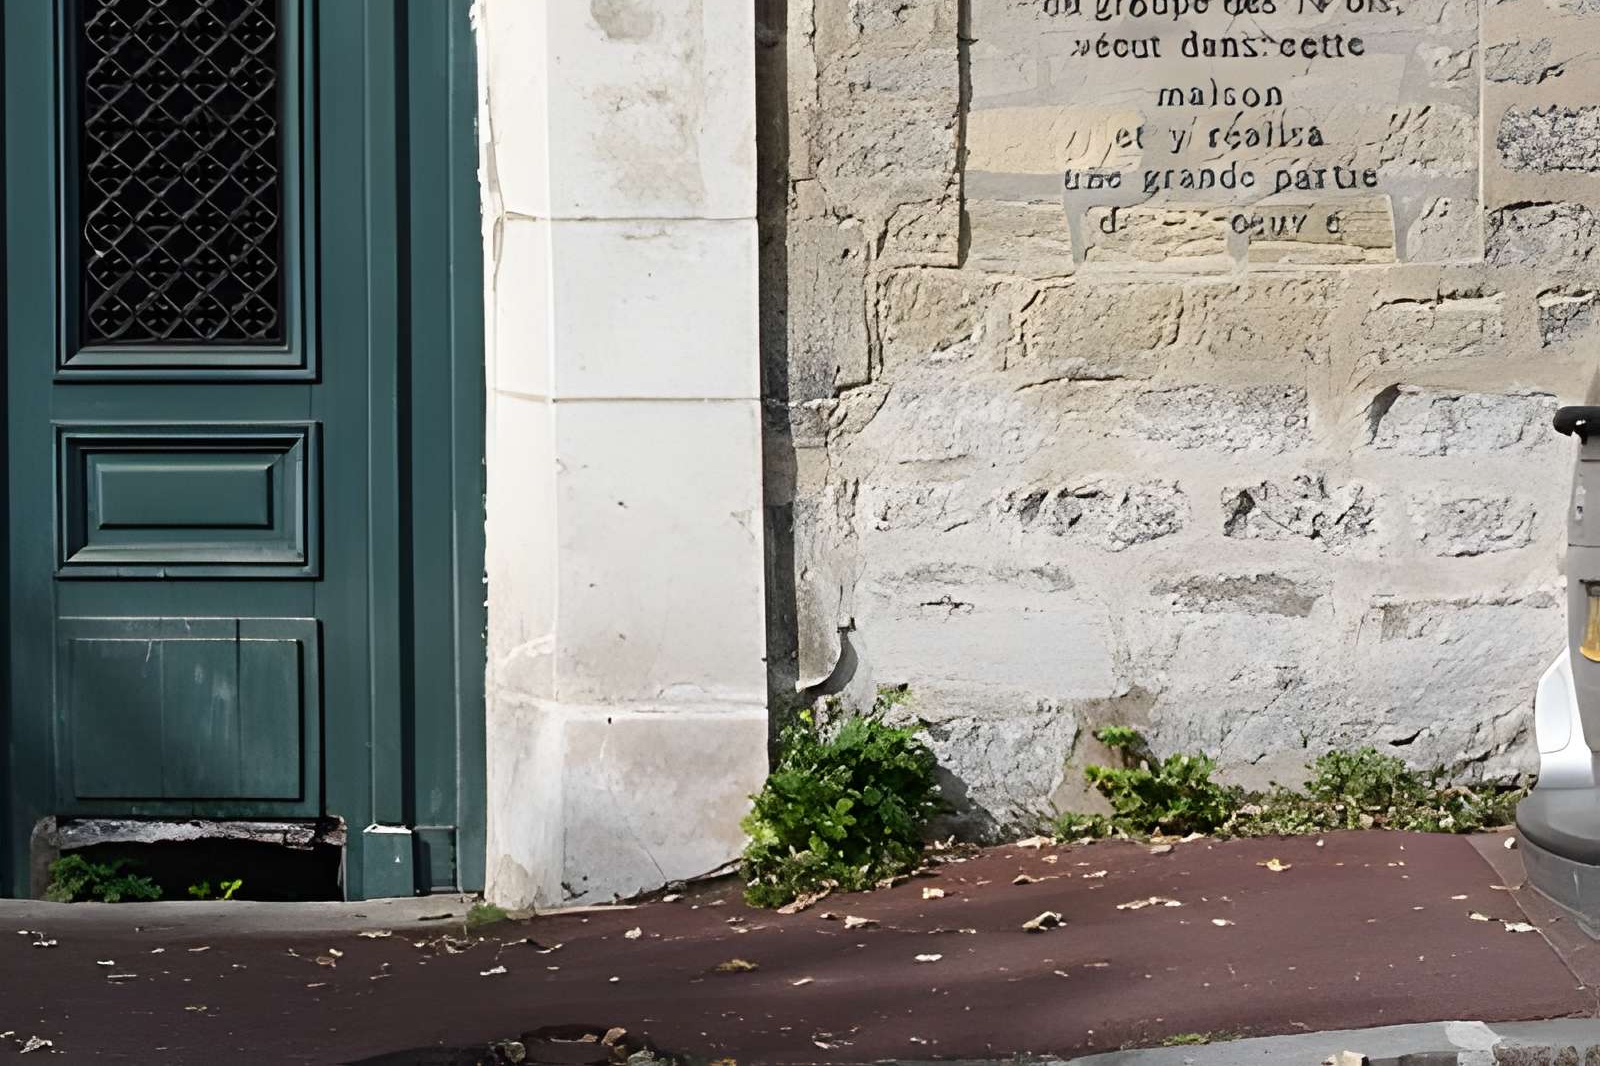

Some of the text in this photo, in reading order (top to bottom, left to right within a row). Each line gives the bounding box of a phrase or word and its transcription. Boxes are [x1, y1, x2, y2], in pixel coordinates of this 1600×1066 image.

[1280, 32, 1366, 60] cette
[1114, 124, 1146, 150] et
[1167, 124, 1186, 155] y
[1274, 166, 1378, 194] partie
